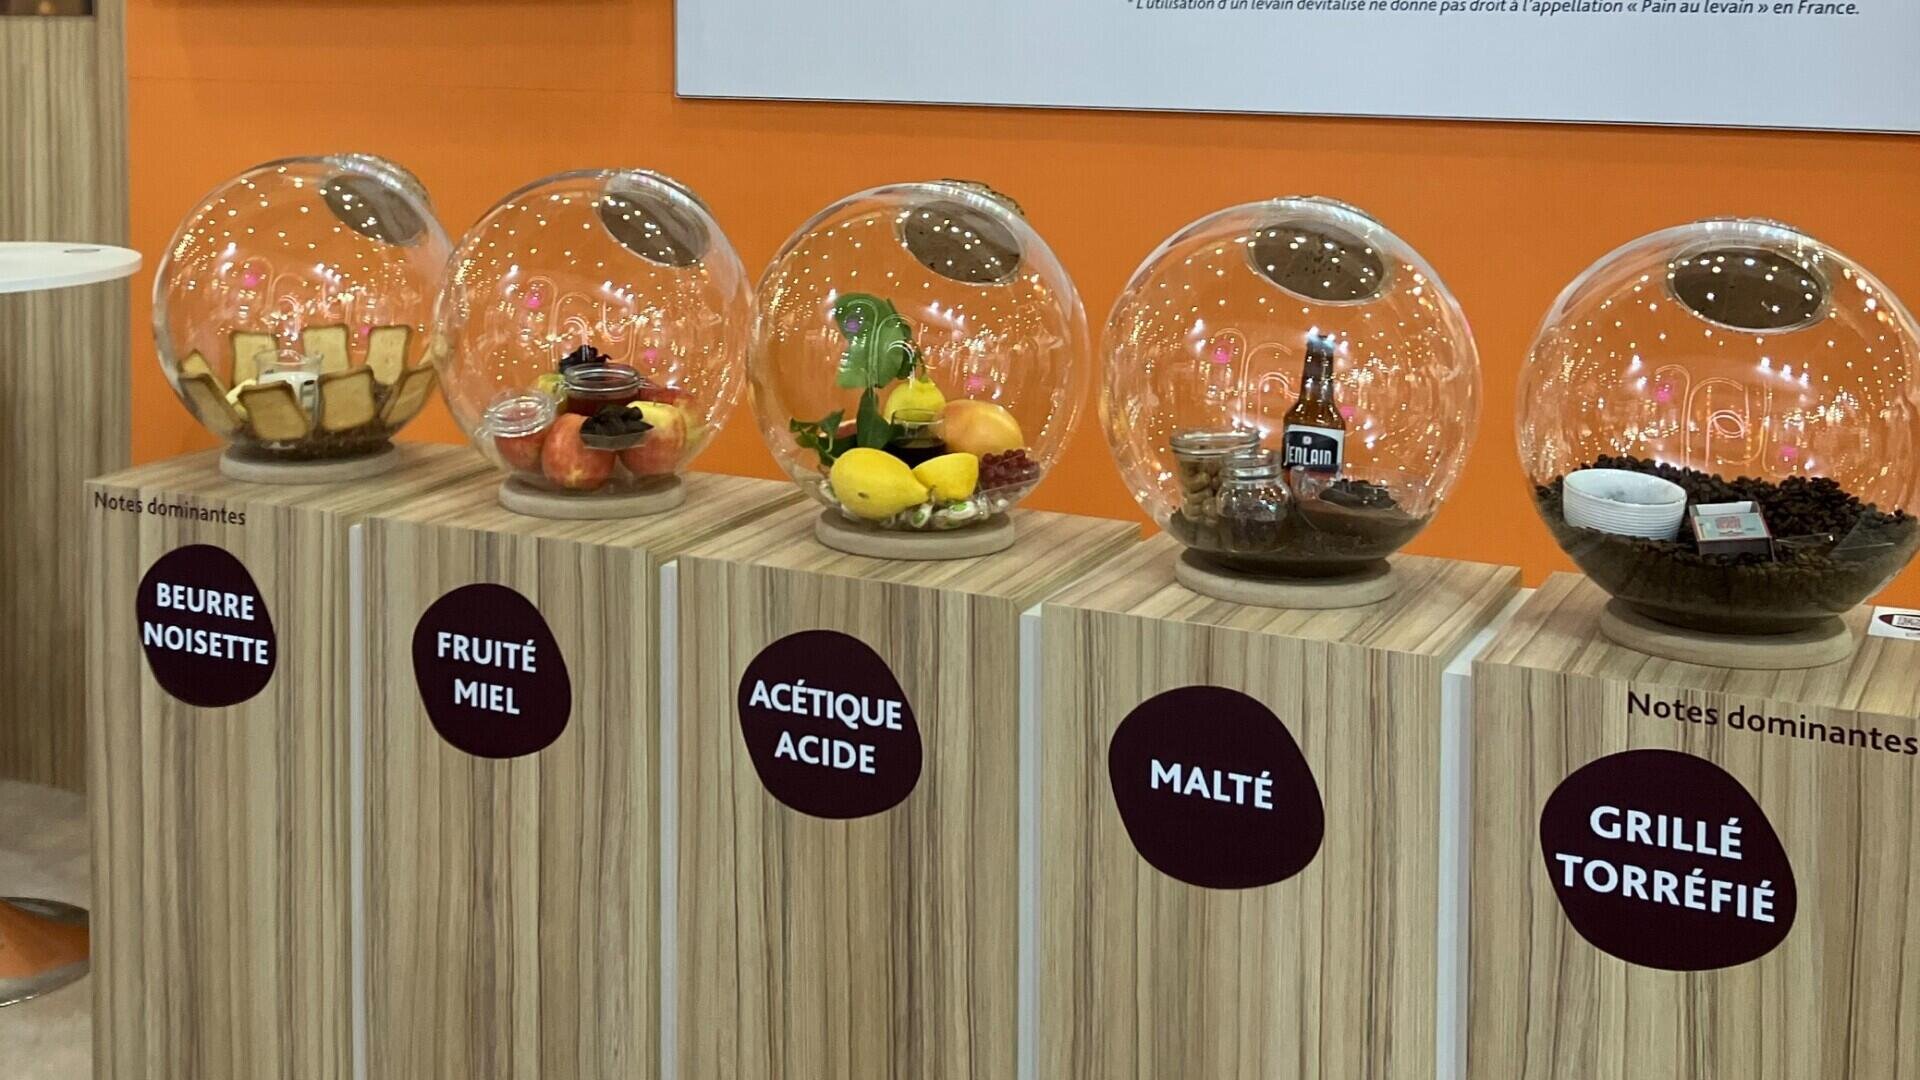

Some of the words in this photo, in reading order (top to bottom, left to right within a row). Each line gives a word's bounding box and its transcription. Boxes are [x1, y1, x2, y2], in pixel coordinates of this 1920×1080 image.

[1136, 0, 1215, 10] Lutilisation
[1216, 0, 1248, 10] dun
[1251, 0, 1294, 10] levain
[1368, 0, 1388, 11] ne
[1390, 0, 1437, 12] donne
[1439, 0, 1467, 16] pas
[1469, 0, 1507, 12] droit
[1641, 0, 1677, 14] Pain
[1679, 2, 1701, 14] au
[1703, 0, 1754, 14] levain
[1772, 2, 1794, 15] en
[1797, 0, 1860, 15] France.
[1283, 442, 1332, 466] JENLAIN
[94, 491, 143, 514] Notes
[147, 497, 247, 526] dominantes
[156, 582, 255, 621] BEURRE
[143, 621, 269, 666] NOISETTE
[437, 631, 537, 673] FRUITÉ
[454, 678, 520, 715] MIEL
[749, 679, 902, 731] ACÉTIQUE
[1627, 691, 1718, 726] Notes
[1727, 705, 1919, 756] dominantes
[774, 731, 876, 774] ACIDE
[1150, 758, 1273, 810] MALTÉ
[1589, 805, 1743, 860] GRILLÉ
[1555, 852, 1776, 923] TORRÉFIÉ
